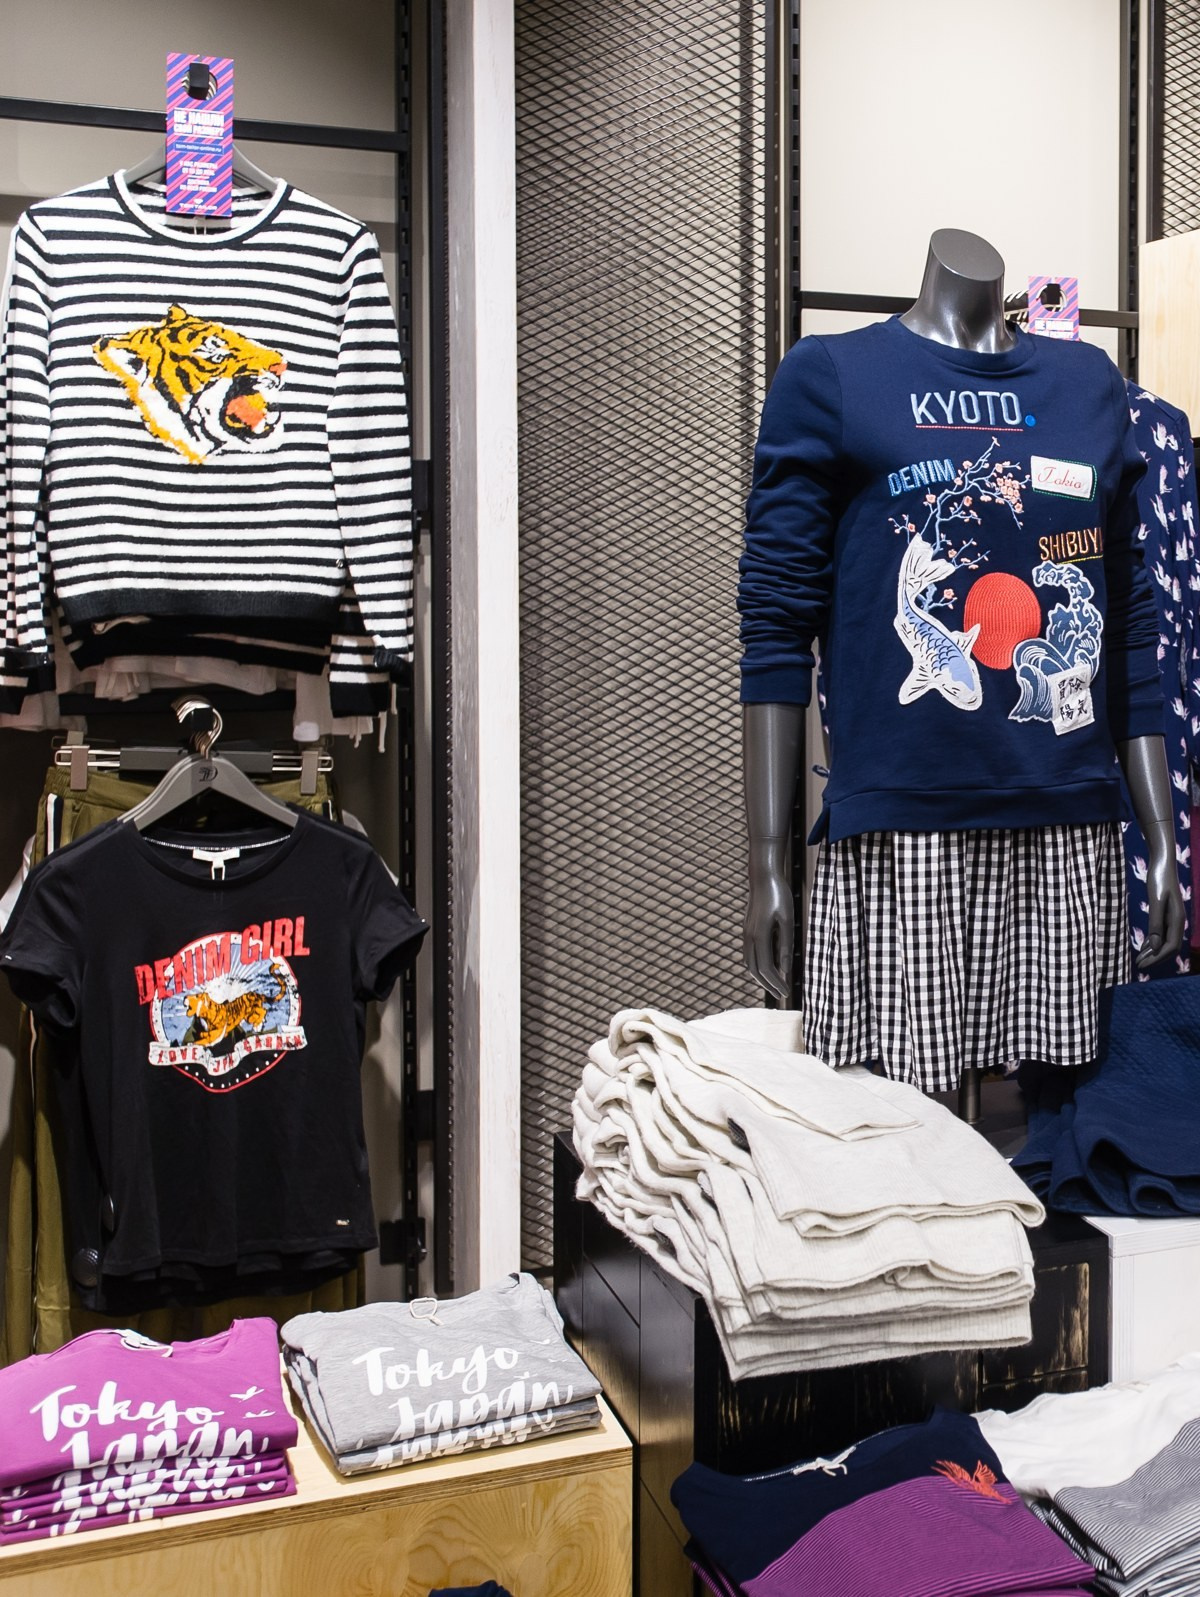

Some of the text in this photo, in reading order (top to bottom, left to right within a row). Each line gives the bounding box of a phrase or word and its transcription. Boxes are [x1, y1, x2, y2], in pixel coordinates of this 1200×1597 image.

[887, 458, 957, 497] DENIM
[1038, 527, 1103, 561] SHIBUY
[134, 915, 310, 1006] DENIM GIRL
[352, 1345, 524, 1396] Tokyo
[29, 1380, 224, 1441] Tokyo
